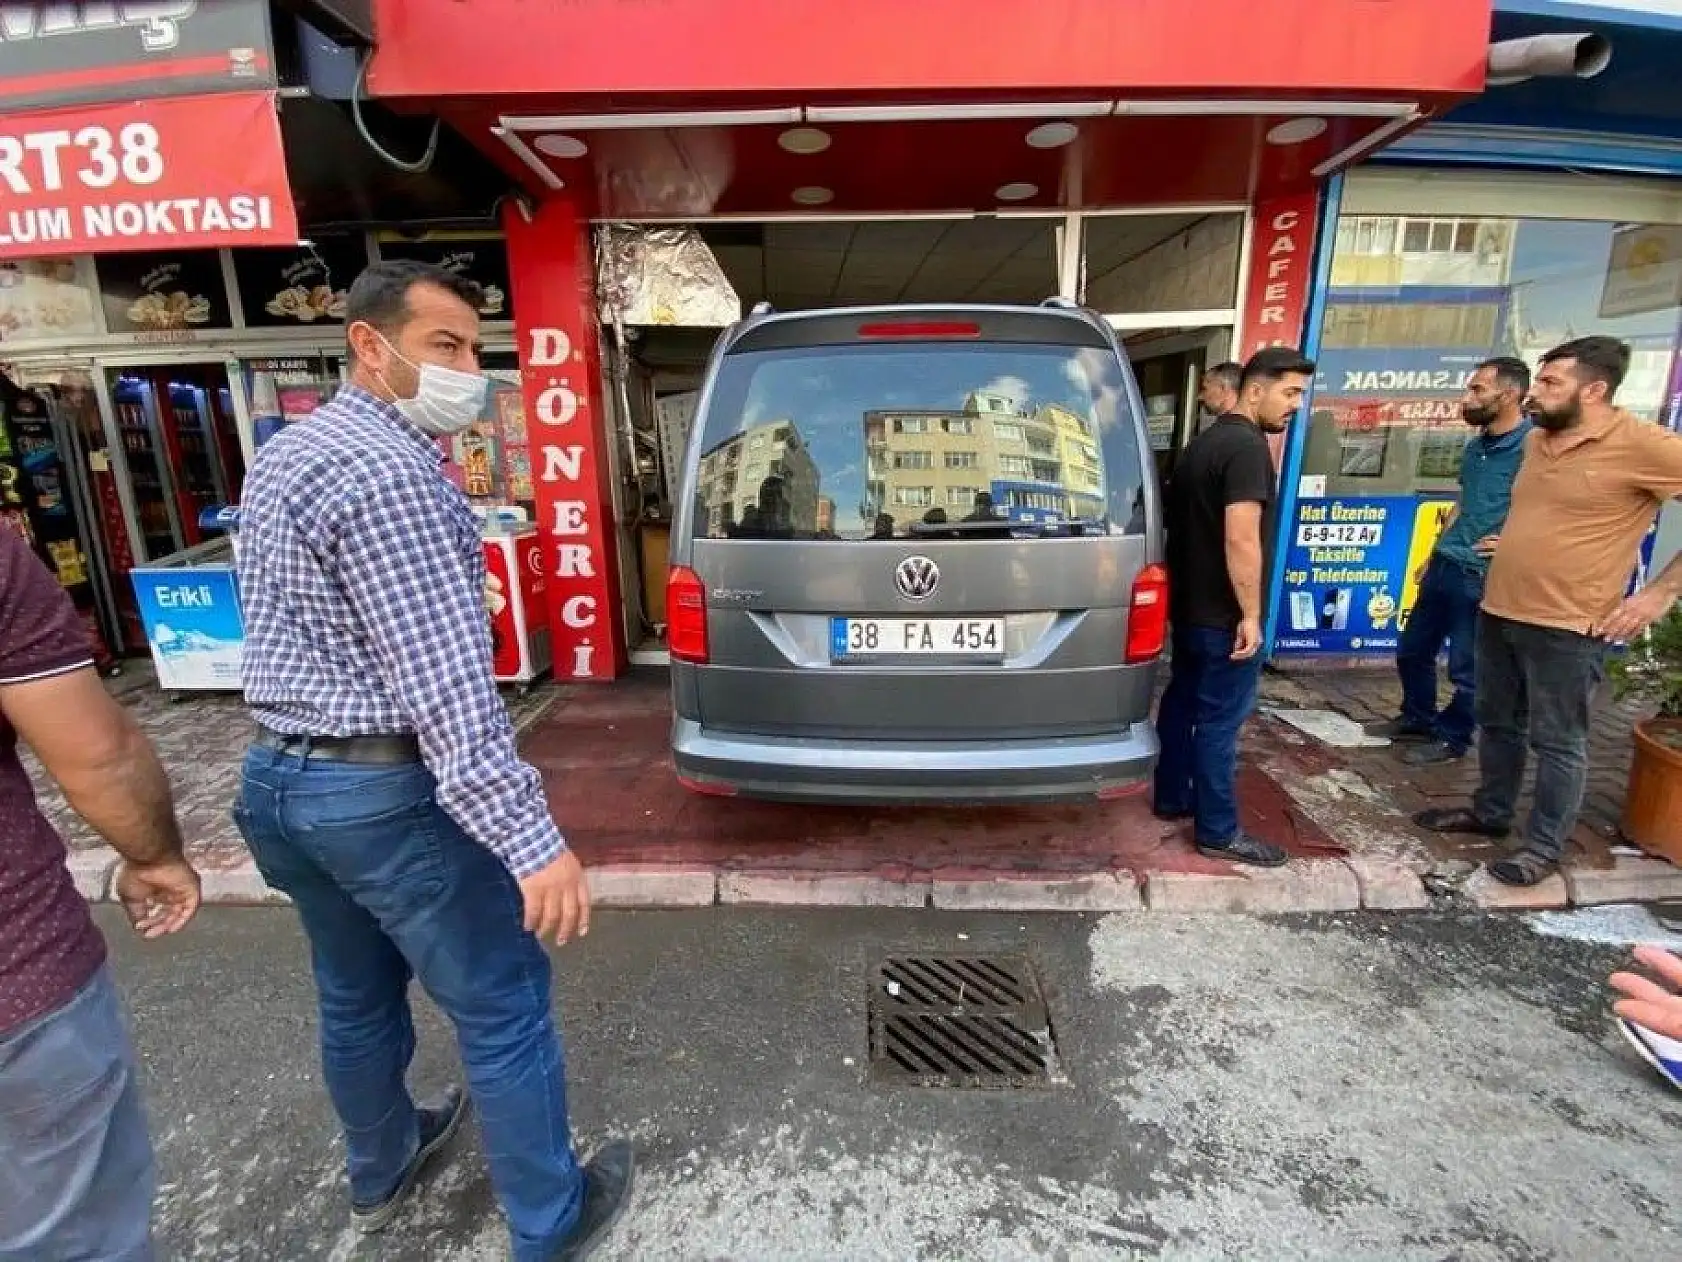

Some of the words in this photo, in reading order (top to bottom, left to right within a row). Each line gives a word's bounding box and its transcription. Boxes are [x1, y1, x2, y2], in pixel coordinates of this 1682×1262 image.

[0, 122, 164, 195] RT38
[83, 194, 272, 238] NOKTASI
[1259, 210, 1299, 325] CAFER
[528, 327, 598, 677] DÖNERCİ
[1300, 505, 1326, 521] Hat
[1330, 501, 1387, 521] Üzerine
[1303, 526, 1355, 542] 6-9-12
[1358, 526, 1378, 544] Ay
[154, 585, 215, 608] Erikli
[850, 622, 879, 649] 38
[903, 622, 933, 649] FA
[951, 621, 999, 648] 454
